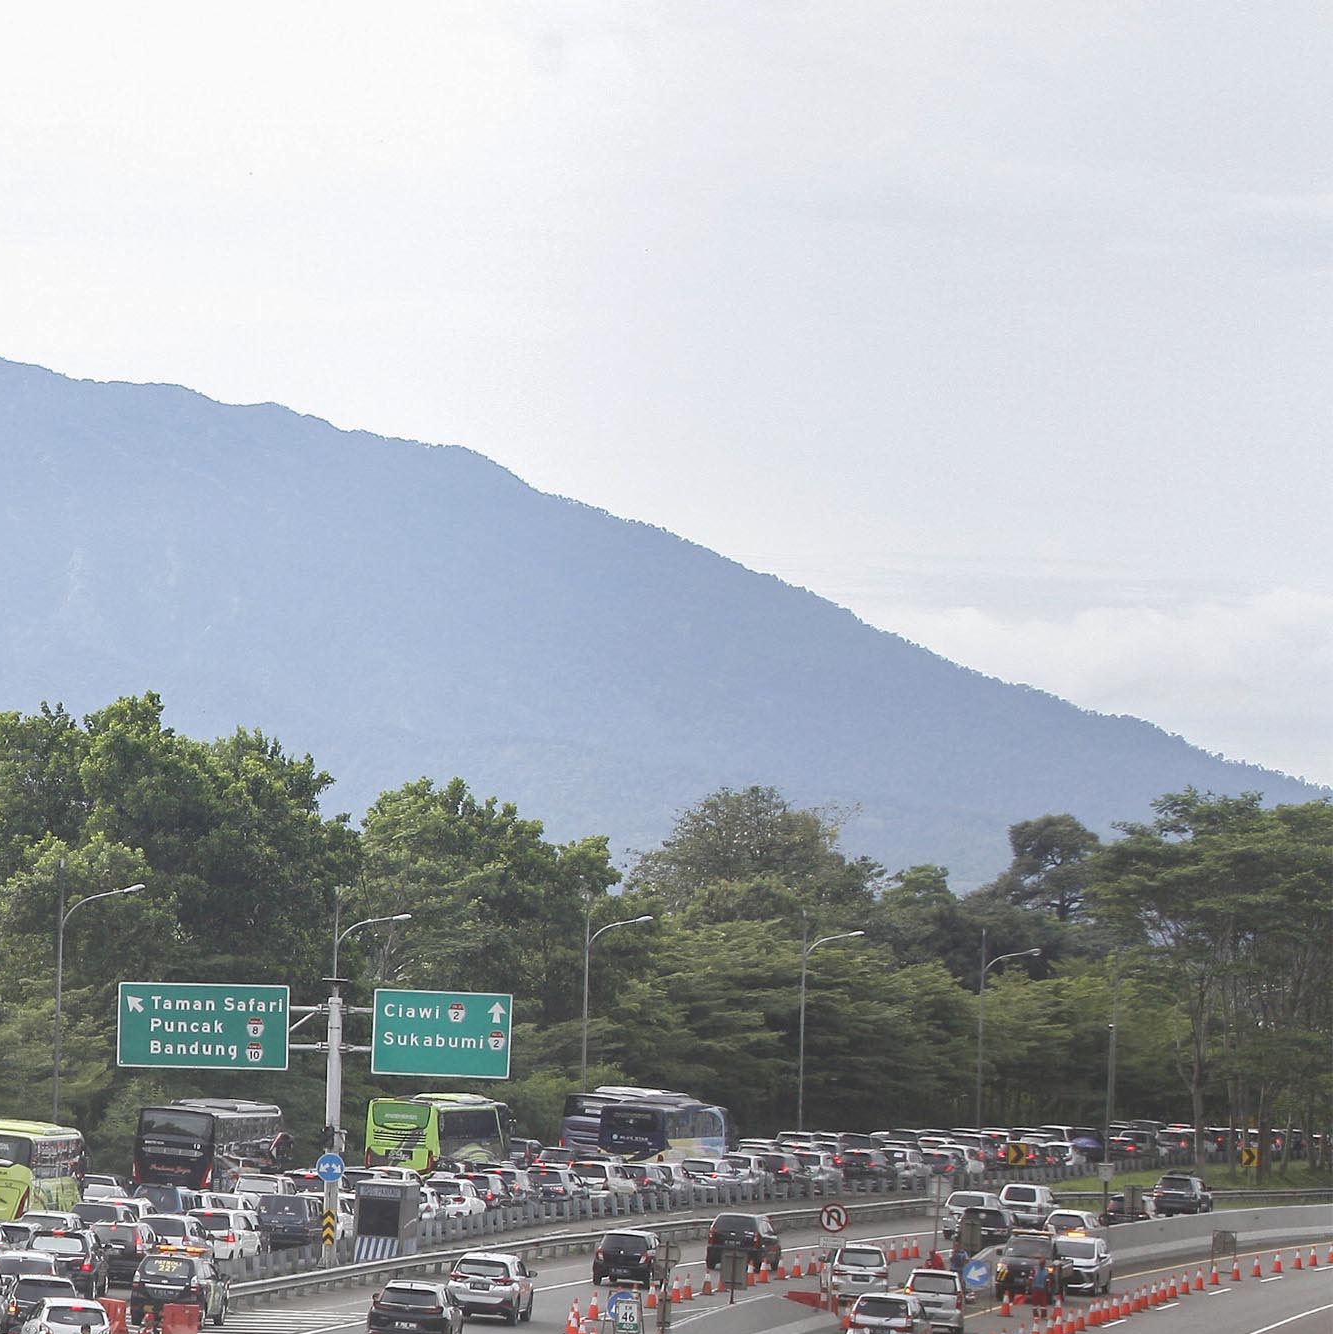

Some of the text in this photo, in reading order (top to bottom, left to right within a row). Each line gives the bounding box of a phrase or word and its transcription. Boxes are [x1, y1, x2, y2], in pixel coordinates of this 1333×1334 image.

[151, 996, 283, 1012] Taman Safari
[384, 1003, 459, 1020] Ciawi 2
[150, 1018, 259, 1035] Puncak 8
[383, 1031, 500, 1049] Sukabumi 2
[150, 1040, 259, 1060] Bandung 10
[622, 1312, 635, 1322] 46
